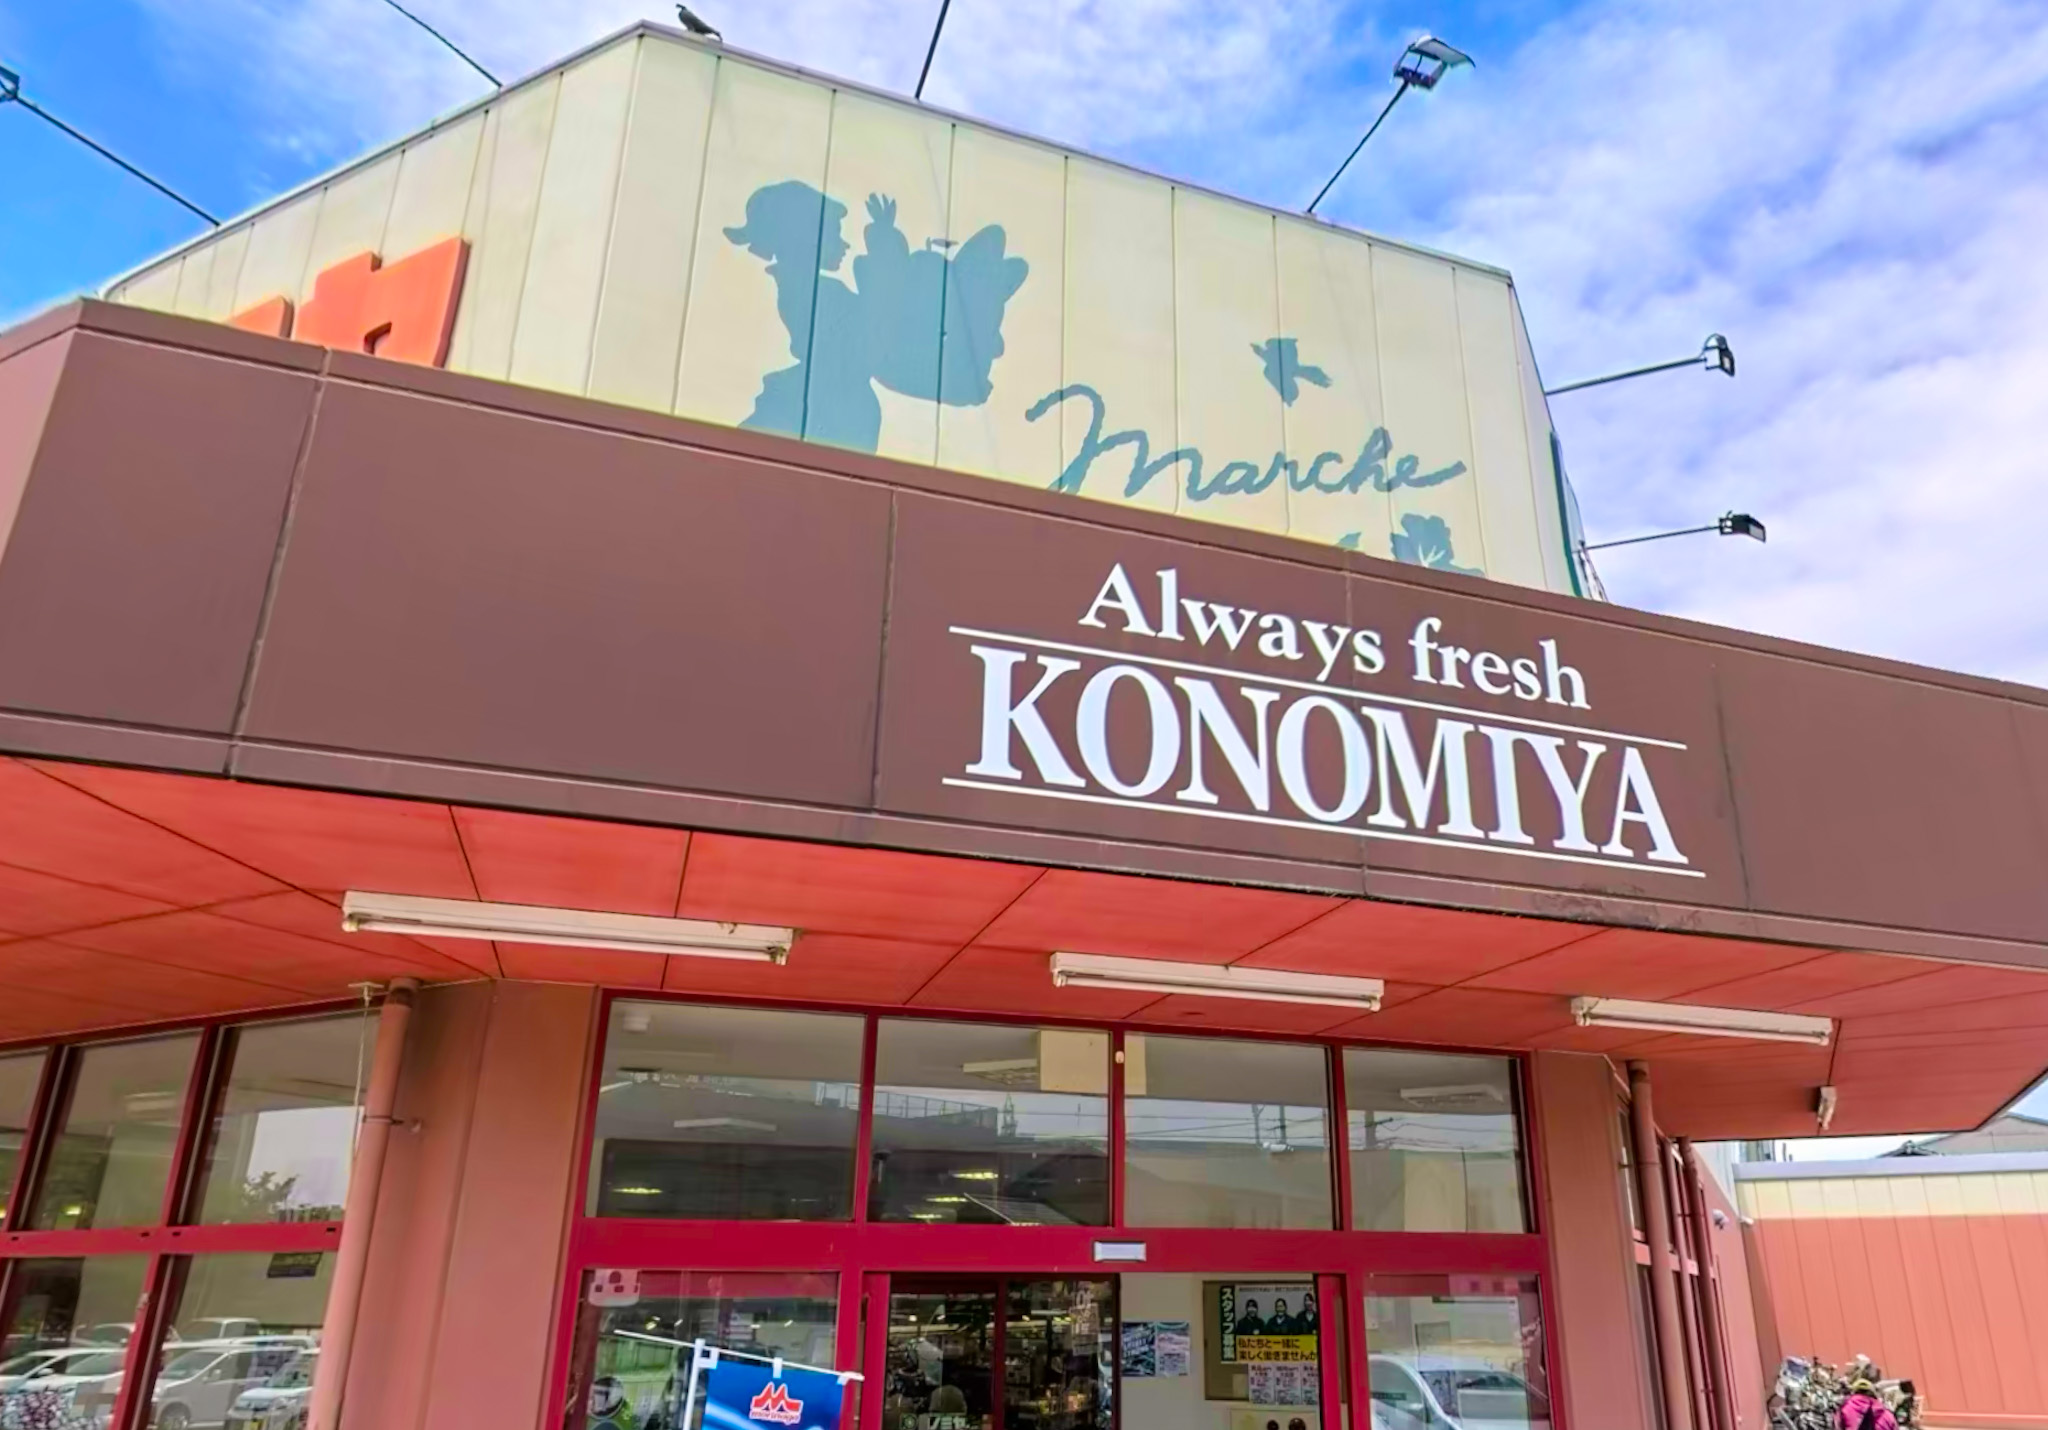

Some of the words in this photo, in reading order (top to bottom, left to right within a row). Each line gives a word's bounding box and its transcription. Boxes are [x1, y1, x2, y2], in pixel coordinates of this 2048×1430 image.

[1079, 563, 1386, 683] Always
[1409, 617, 1592, 710] fresh
[965, 644, 1690, 866] KONOMIYA
